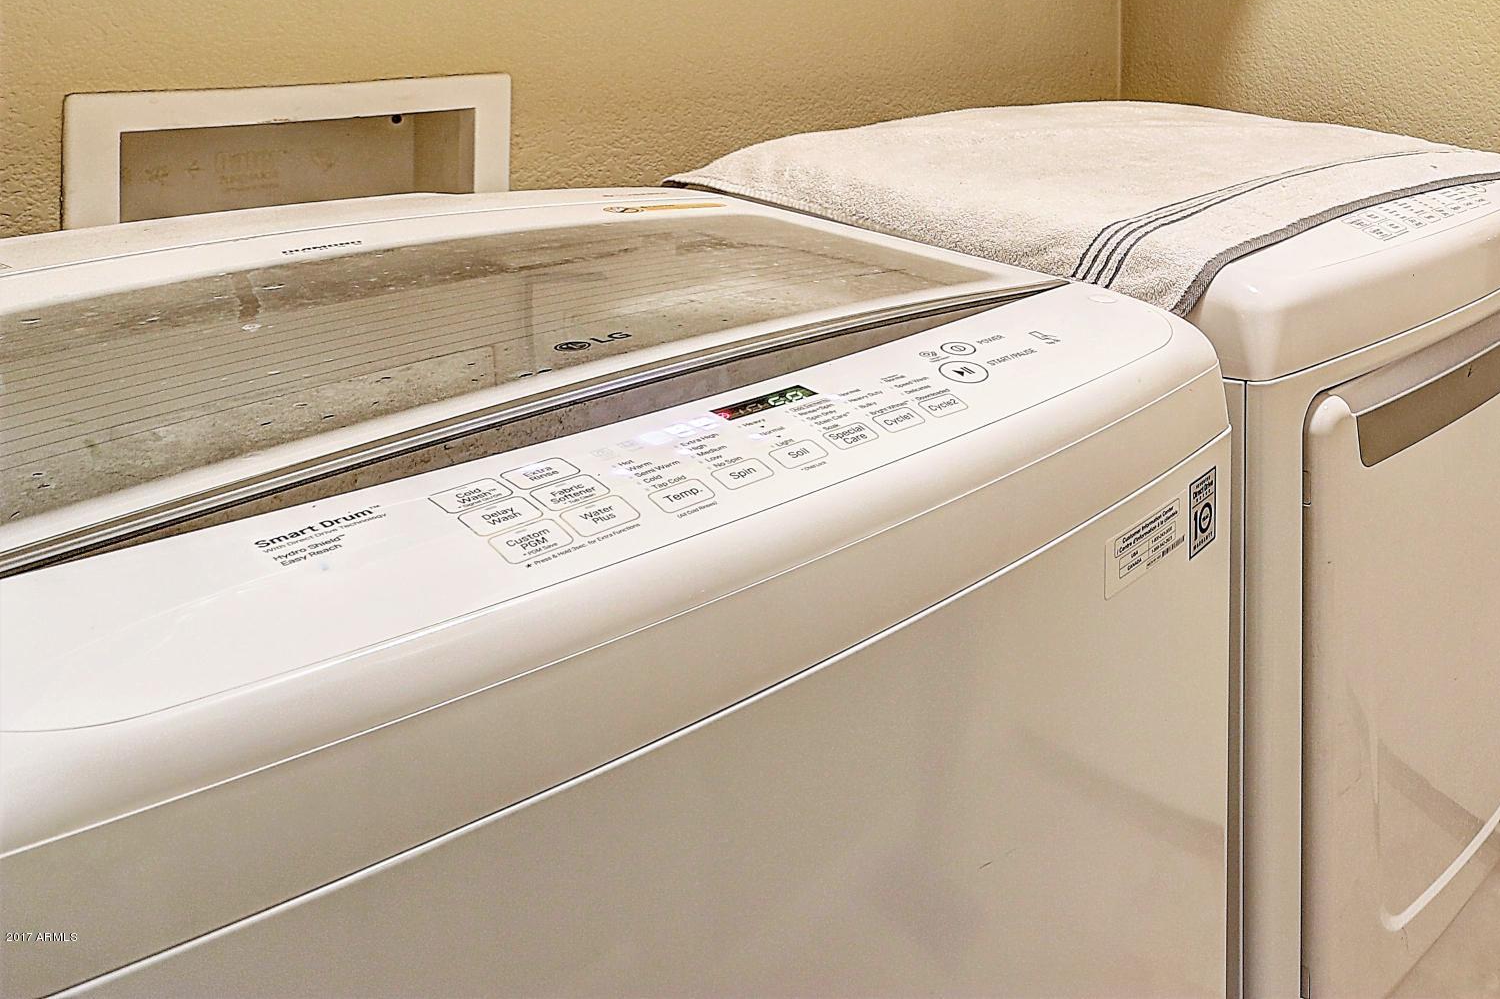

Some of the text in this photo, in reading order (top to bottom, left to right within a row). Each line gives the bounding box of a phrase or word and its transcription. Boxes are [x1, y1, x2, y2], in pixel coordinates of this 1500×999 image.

[589, 331, 633, 344] LG
[976, 334, 1005, 345] POWER
[928, 398, 959, 412] Cycle2
[883, 412, 915, 426] Cycle1
[680, 432, 719, 447] Extra High
[828, 425, 866, 441] Special
[843, 433, 868, 445] Care
[690, 443, 708, 451] High
[775, 438, 794, 448] Light
[696, 444, 728, 458] Medium
[787, 447, 811, 459] Soil
[627, 461, 653, 472] Warm
[725, 456, 743, 465] Spin
[522, 466, 553, 478] Extra
[529, 470, 560, 481] Rinse
[634, 460, 680, 478] Semi Warm
[728, 466, 757, 480] Spin
[643, 474, 663, 484] Cold
[651, 474, 687, 490] Tap Cold
[455, 487, 482, 499] Cold
[550, 483, 585, 497] Fabric
[550, 486, 597, 504] Softener
[662, 486, 704, 503] Temp.
[481, 507, 514, 521] Delay
[487, 512, 522, 526] Wash
[580, 505, 614, 520] Water
[592, 513, 617, 524] Plus
[1193, 501, 1213, 541] 10
[254, 525, 319, 548] Smart
[262, 513, 387, 554] With Direct Drive Technology
[505, 528, 551, 547] Custom
[520, 537, 549, 550] PGM
[534, 556, 552, 565] Press
[612, 523, 641, 536] Functions
[272, 547, 307, 561] Hydro
[280, 544, 343, 566] Easy Reach
